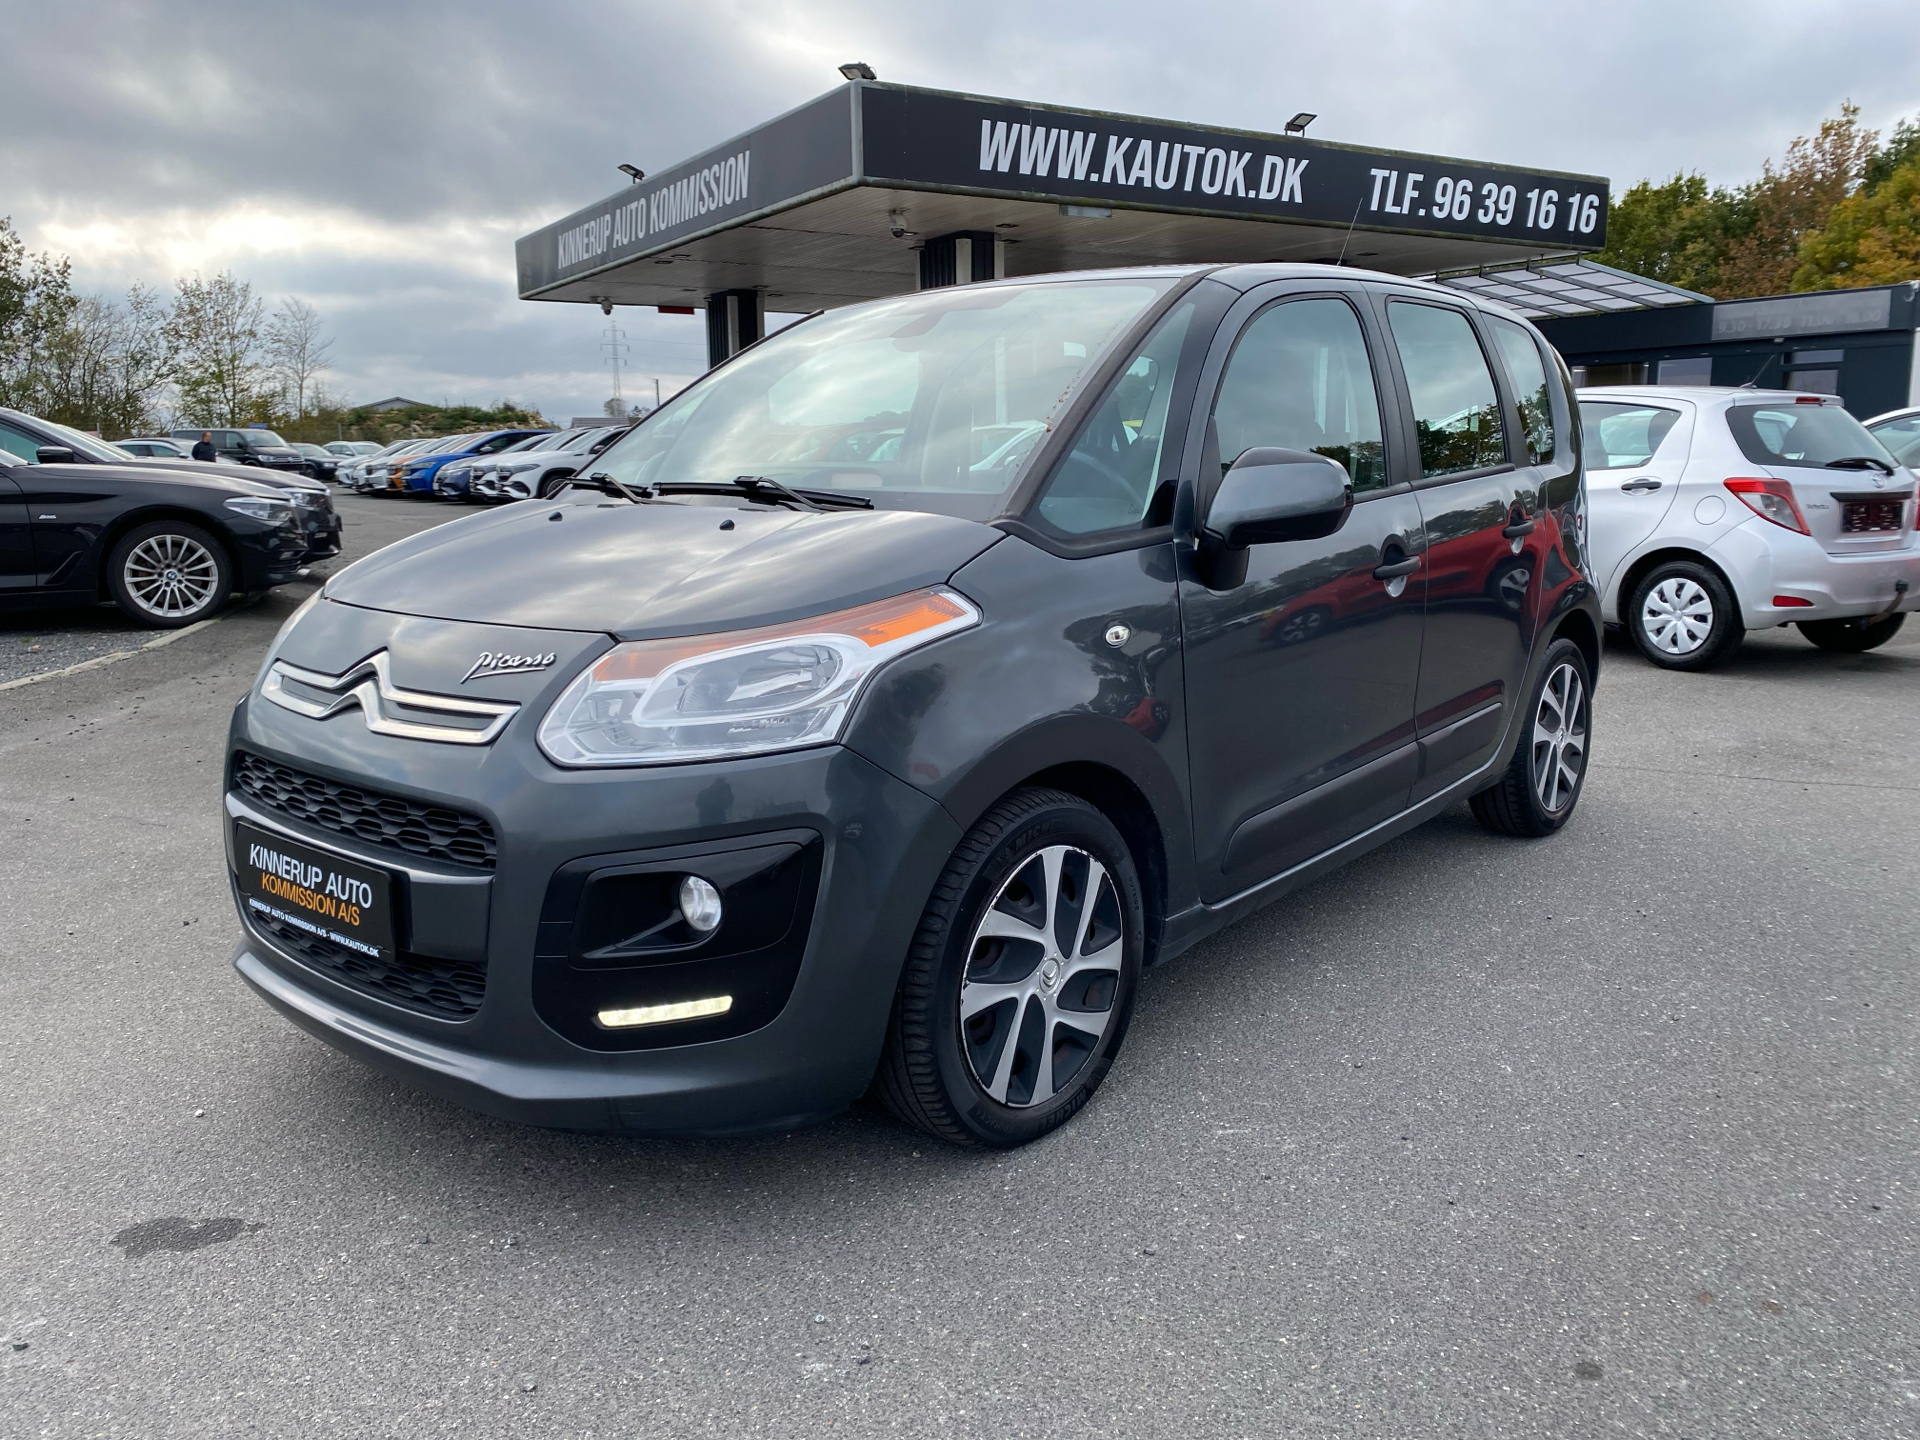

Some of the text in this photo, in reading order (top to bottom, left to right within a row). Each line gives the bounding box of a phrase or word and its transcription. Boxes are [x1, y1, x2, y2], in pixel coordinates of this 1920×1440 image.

[978, 119, 1310, 204] WWW.KAUTOK.DK
[557, 150, 750, 270] KINNERUP AUTO KOMMISSION
[1370, 168, 1600, 234] TLF. 96 39 16 16
[249, 843, 373, 909] KINNERUP AUTO
[261, 872, 360, 926] KOMMISSION A/S
[1128, 876, 1140, 911] OUTSIDE
[271, 908, 285, 920] AUTO
[284, 913, 317, 934] KOMMISSION
[316, 927, 327, 937] A/S
[329, 931, 380, 958] WWW.KAUTOK.DK
